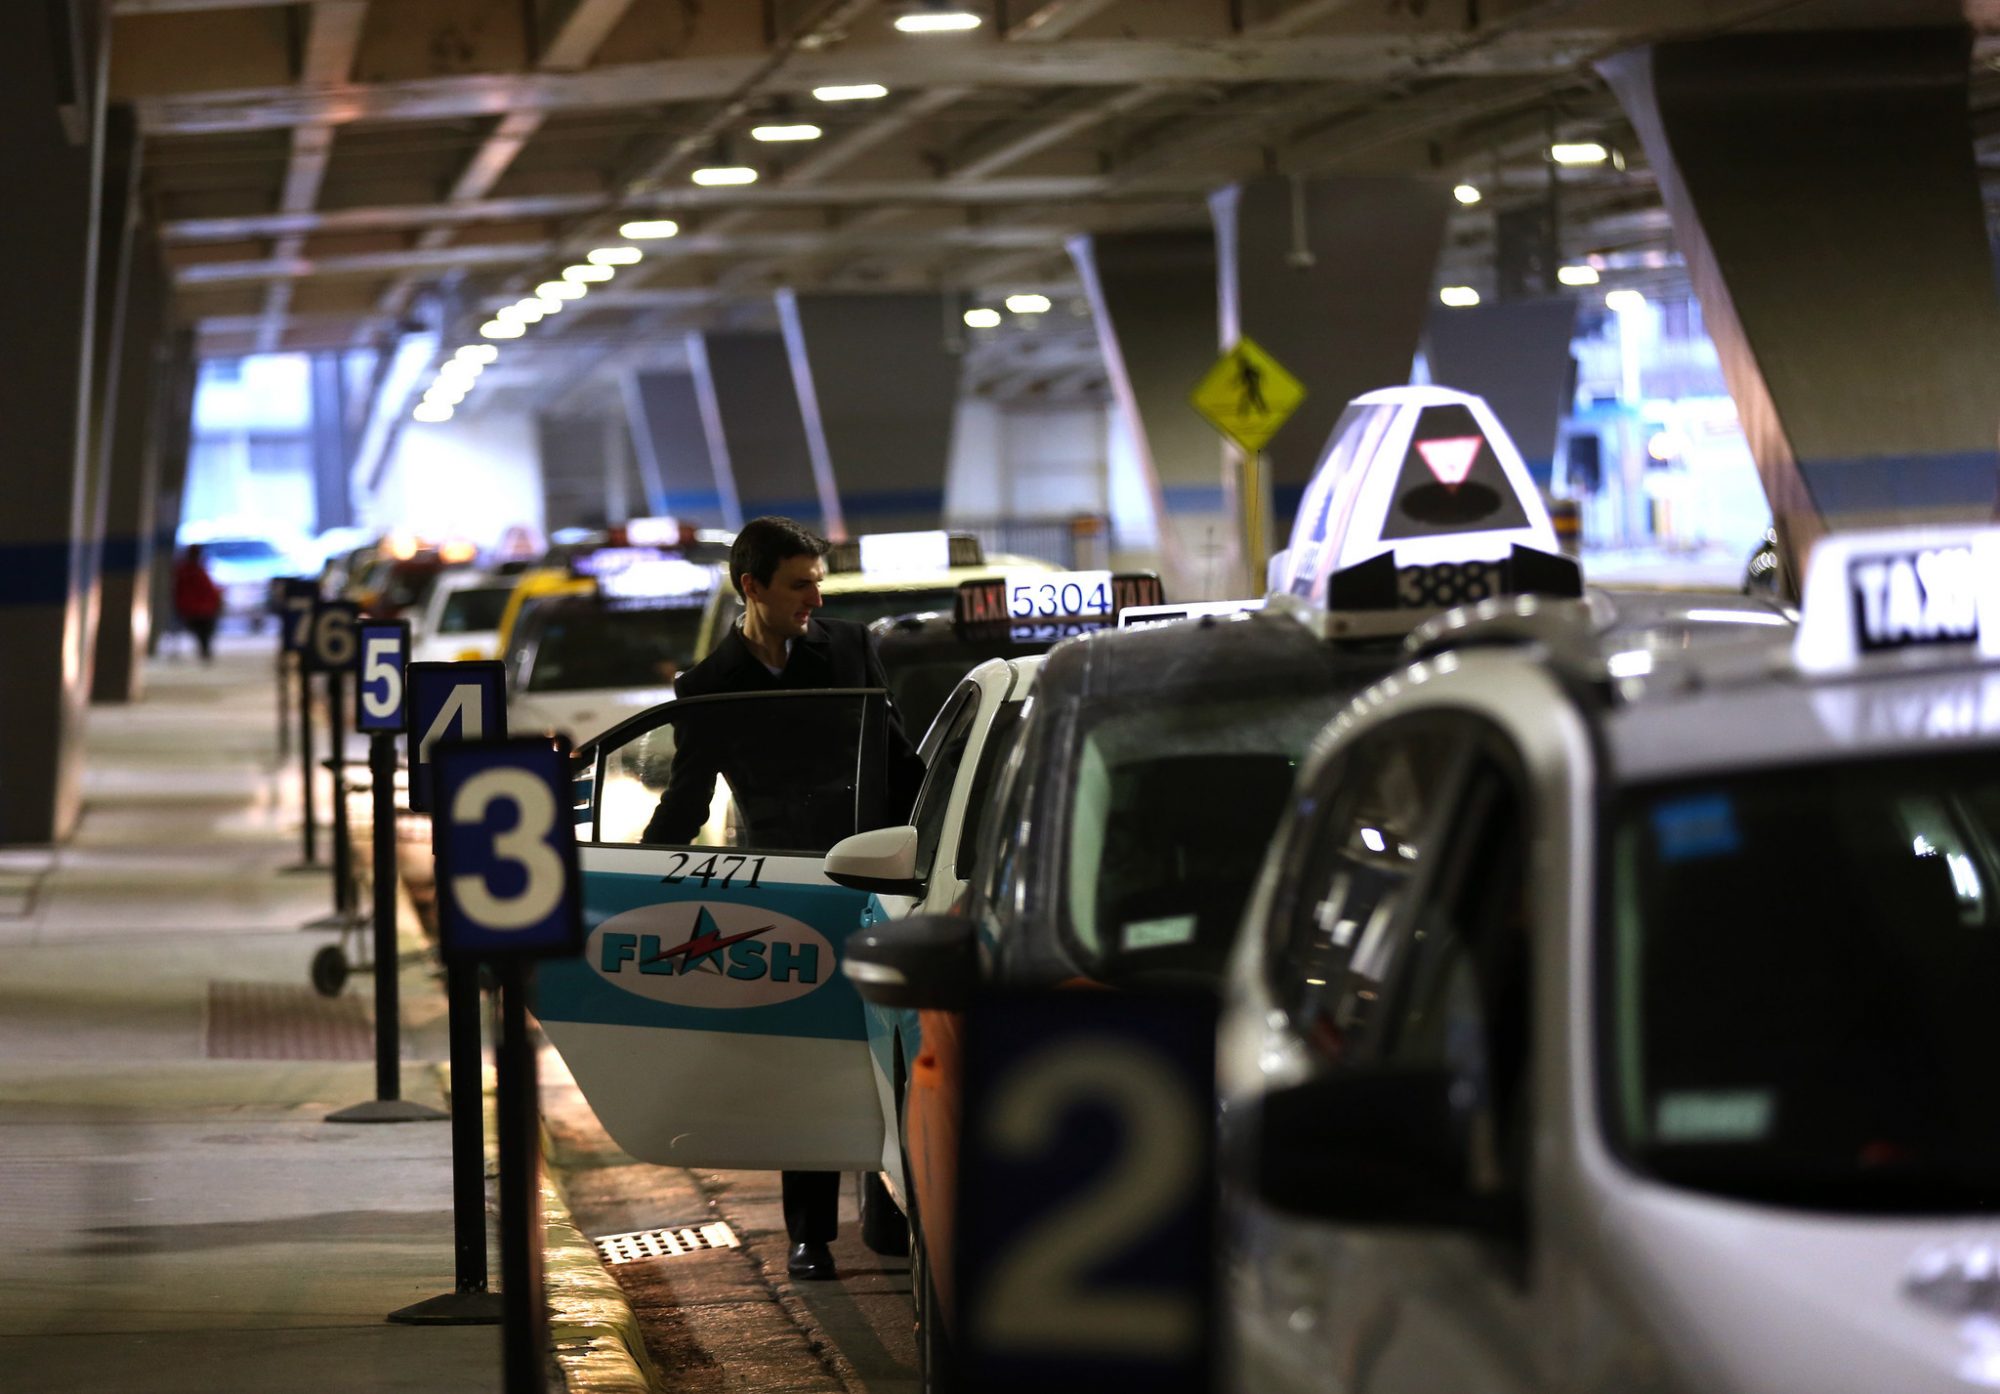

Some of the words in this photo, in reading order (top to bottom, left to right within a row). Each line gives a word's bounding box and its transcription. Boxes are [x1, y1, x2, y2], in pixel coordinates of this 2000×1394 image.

[961, 586, 1006, 621] TAXI
[1012, 582, 1111, 617] 5304
[1112, 578, 1160, 615] TAXI
[1401, 560, 1507, 606] 3881
[288, 596, 313, 645] 7
[315, 609, 356, 663] 6
[362, 637, 404, 718] 5
[419, 683, 484, 765] 4
[453, 767, 566, 930] 3
[660, 853, 767, 889] 2471
[602, 906, 819, 984] FLASH
[983, 1038, 1197, 1348] 2
